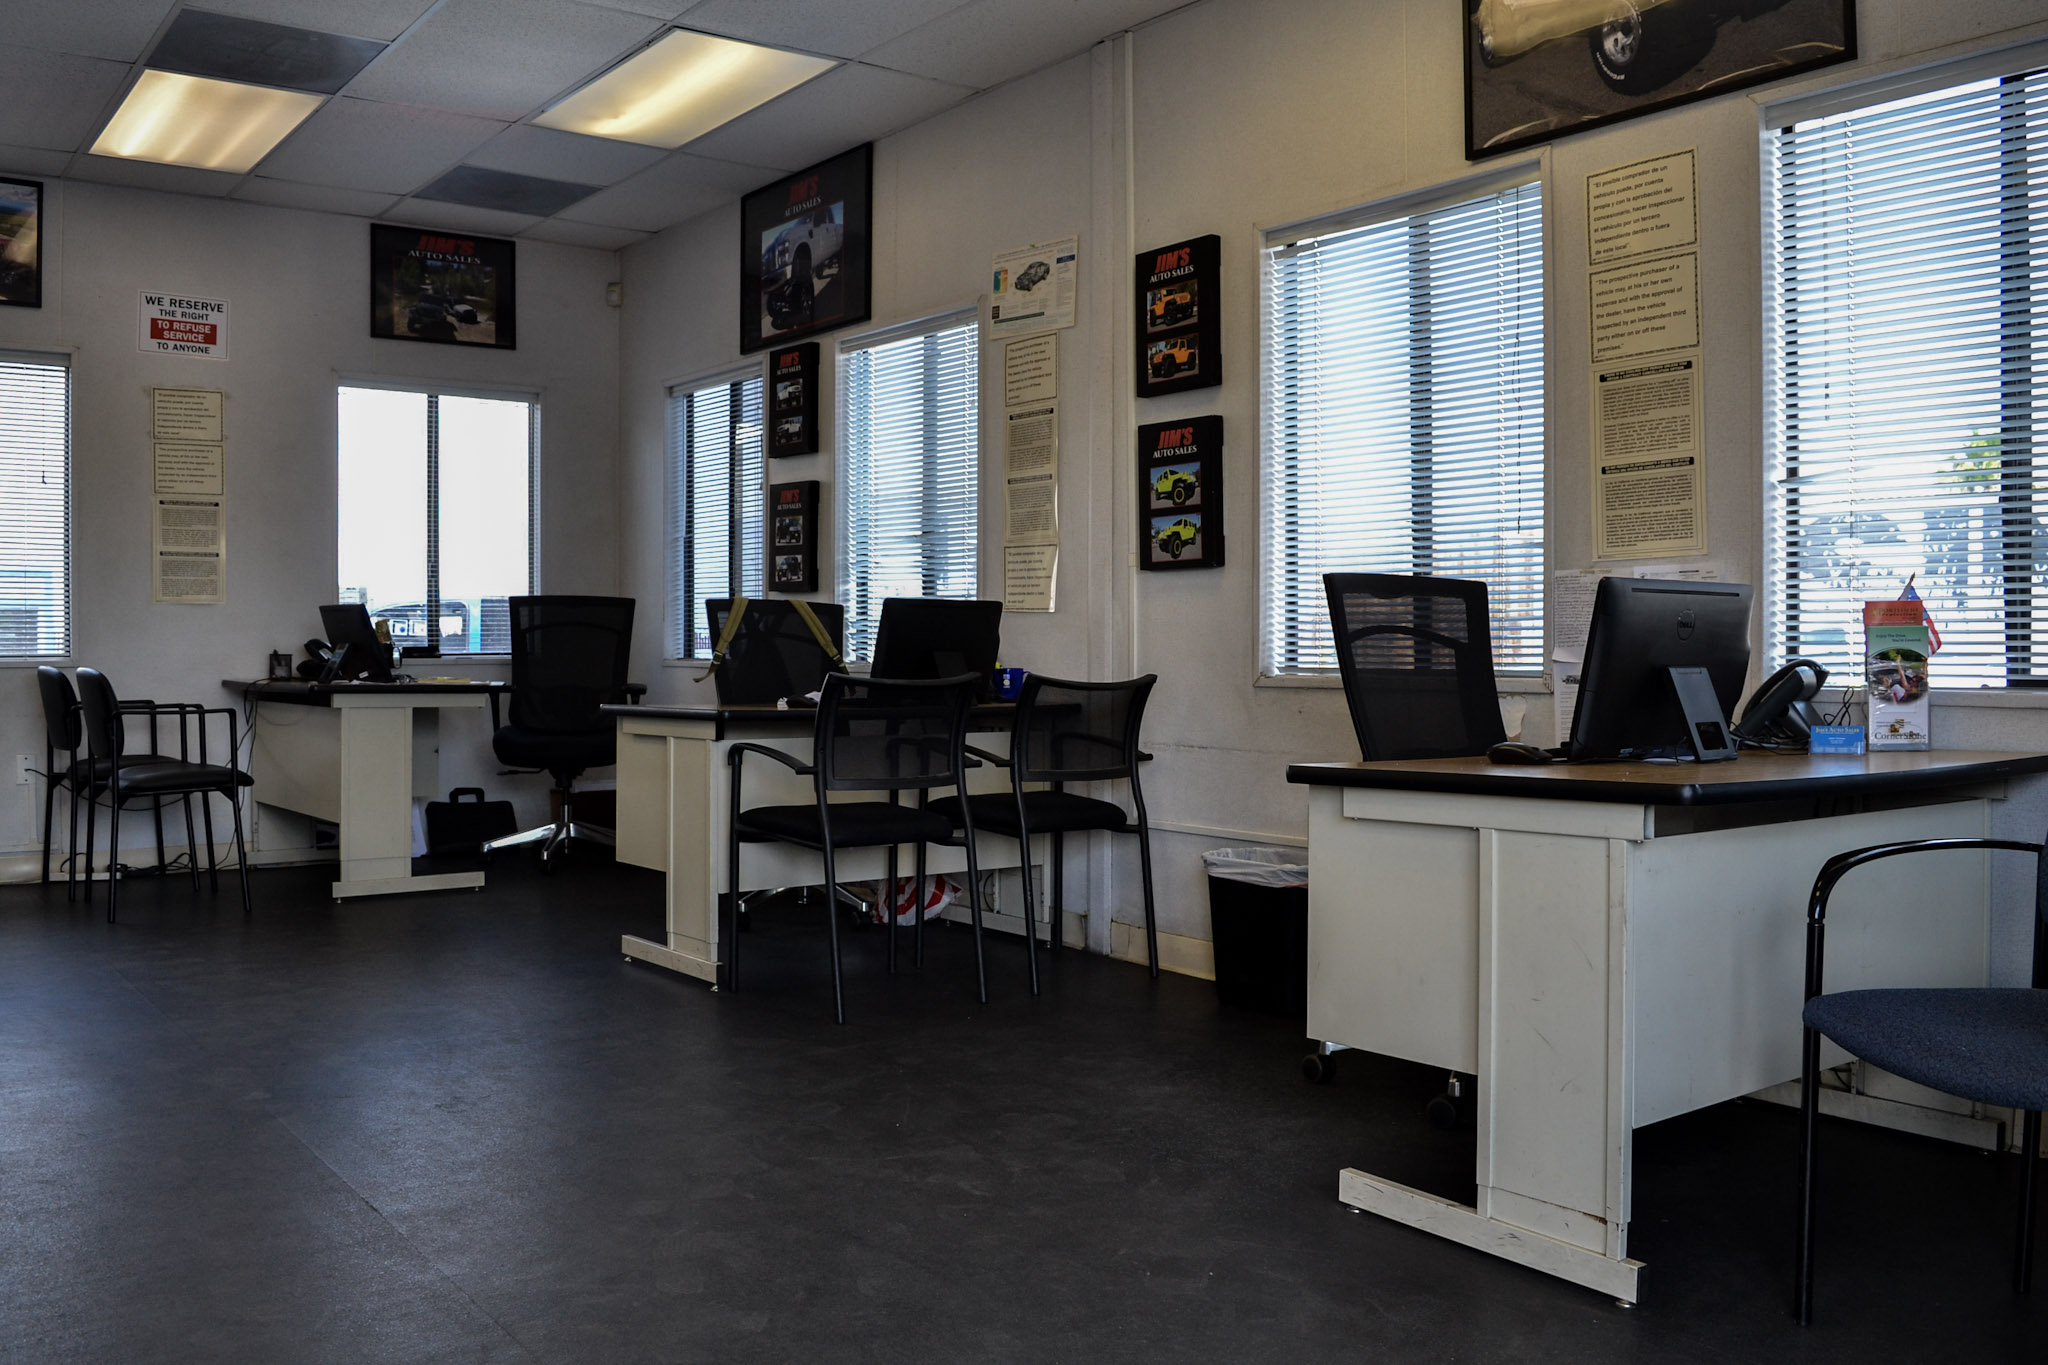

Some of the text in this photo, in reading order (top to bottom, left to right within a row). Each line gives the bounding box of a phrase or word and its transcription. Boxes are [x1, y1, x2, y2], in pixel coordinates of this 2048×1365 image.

[1603, 178, 1620, 187] posible
[1622, 170, 1650, 181] comprador
[1645, 178, 1663, 186] cuenta
[1594, 202, 1610, 211] propia
[1649, 196, 1685, 208] inspeccionar
[1641, 214, 1660, 222] tercero
[1632, 227, 1649, 235] dentro
[408, 250, 481, 265] AUTO SALES
[1154, 248, 1190, 273] JIM'S
[1150, 265, 1194, 283] AUTO SALES
[1609, 273, 1638, 284] prospective
[1640, 267, 1667, 276] purchaser
[1596, 288, 1613, 296] vehicle
[1596, 300, 1617, 308] expense
[1652, 288, 1675, 297] approval
[145, 295, 224, 312] WE RESERVE
[159, 309, 210, 321] THE RIGHT
[1597, 322, 1621, 330] inspected
[1638, 312, 1671, 322] independent
[173, 322, 211, 333] REFUSE
[163, 330, 204, 342] SERVICE
[157, 342, 210, 354] TO ANYONE
[1158, 427, 1193, 449] JIM'S
[1153, 445, 1197, 458] AUTO SALES
